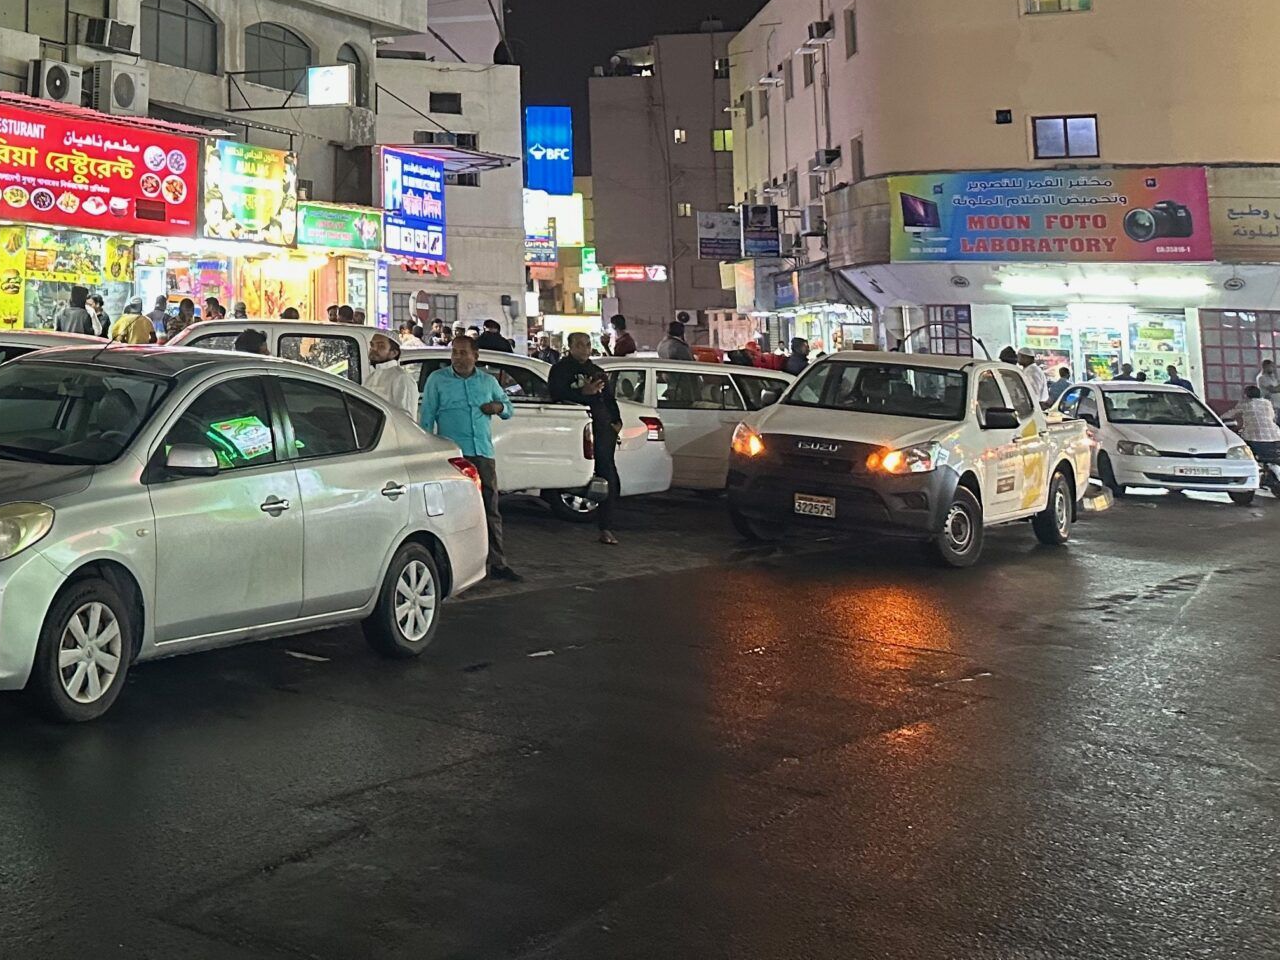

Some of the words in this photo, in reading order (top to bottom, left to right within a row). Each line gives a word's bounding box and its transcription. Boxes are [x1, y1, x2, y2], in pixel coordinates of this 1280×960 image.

[63, 130, 103, 147] ناهيان
[103, 138, 140, 153] مطعم
[546, 148, 570, 160] BFC
[967, 178, 1022, 191] للتصوير
[1026, 177, 1063, 190] القمر
[1068, 176, 1113, 189] مختبر
[952, 195, 1003, 208] الملونة
[1058, 194, 1128, 207] وتحميض
[967, 214, 1031, 230] MOON
[1045, 214, 1107, 230] FOTO
[1233, 223, 1280, 239] لملونة
[960, 237, 1117, 253] LABORATORY
[798, 441, 838, 452] ISUZU
[795, 501, 832, 516] 322575
